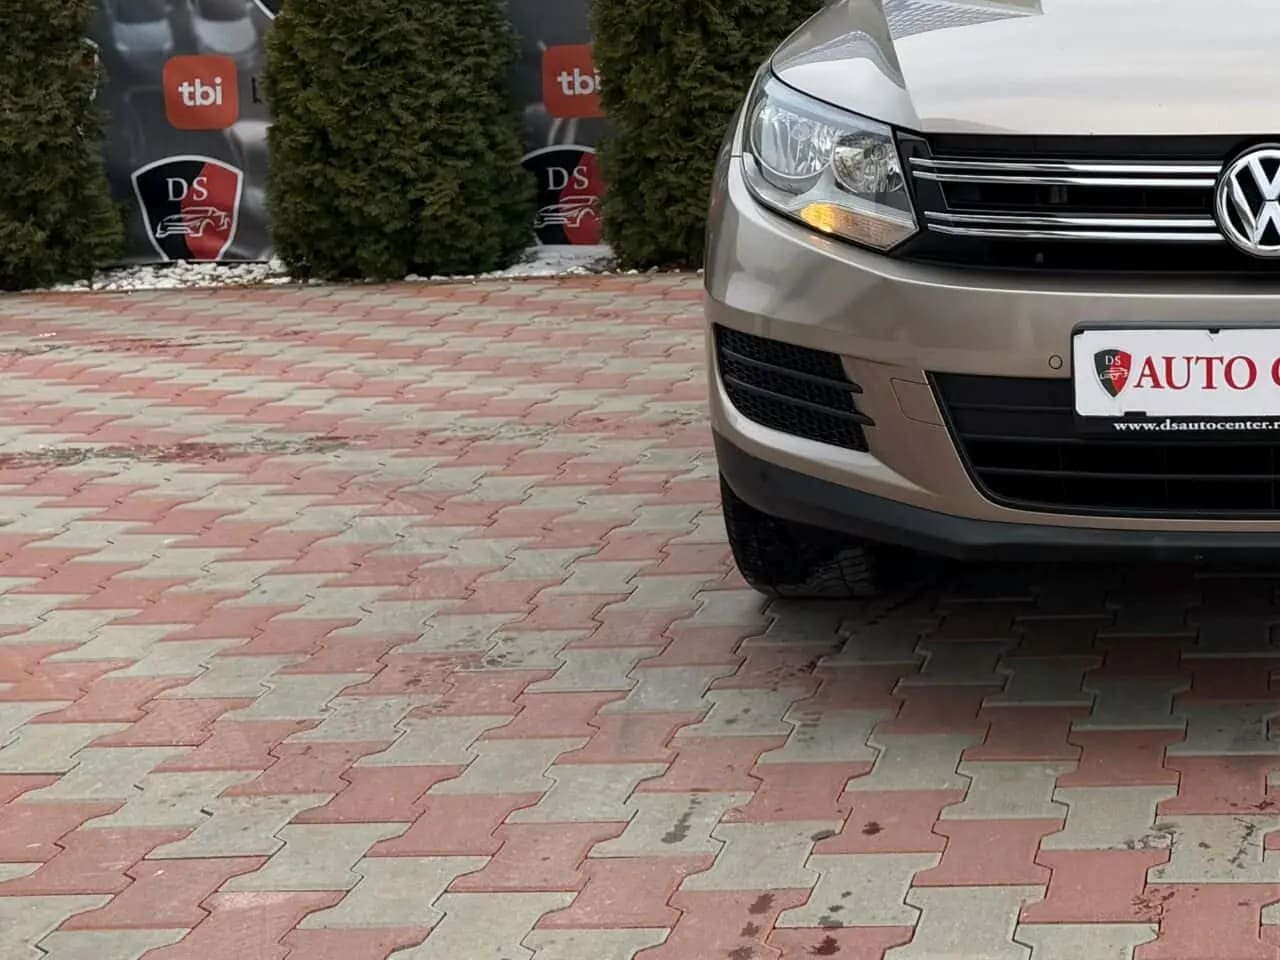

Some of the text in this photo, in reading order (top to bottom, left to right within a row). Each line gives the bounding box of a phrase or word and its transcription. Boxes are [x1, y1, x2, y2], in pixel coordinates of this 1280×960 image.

[178, 77, 222, 106] tbi
[166, 177, 208, 201] DS
[548, 166, 589, 190] DS
[1105, 355, 1121, 366] DS
[1132, 355, 1258, 390] AUTO
